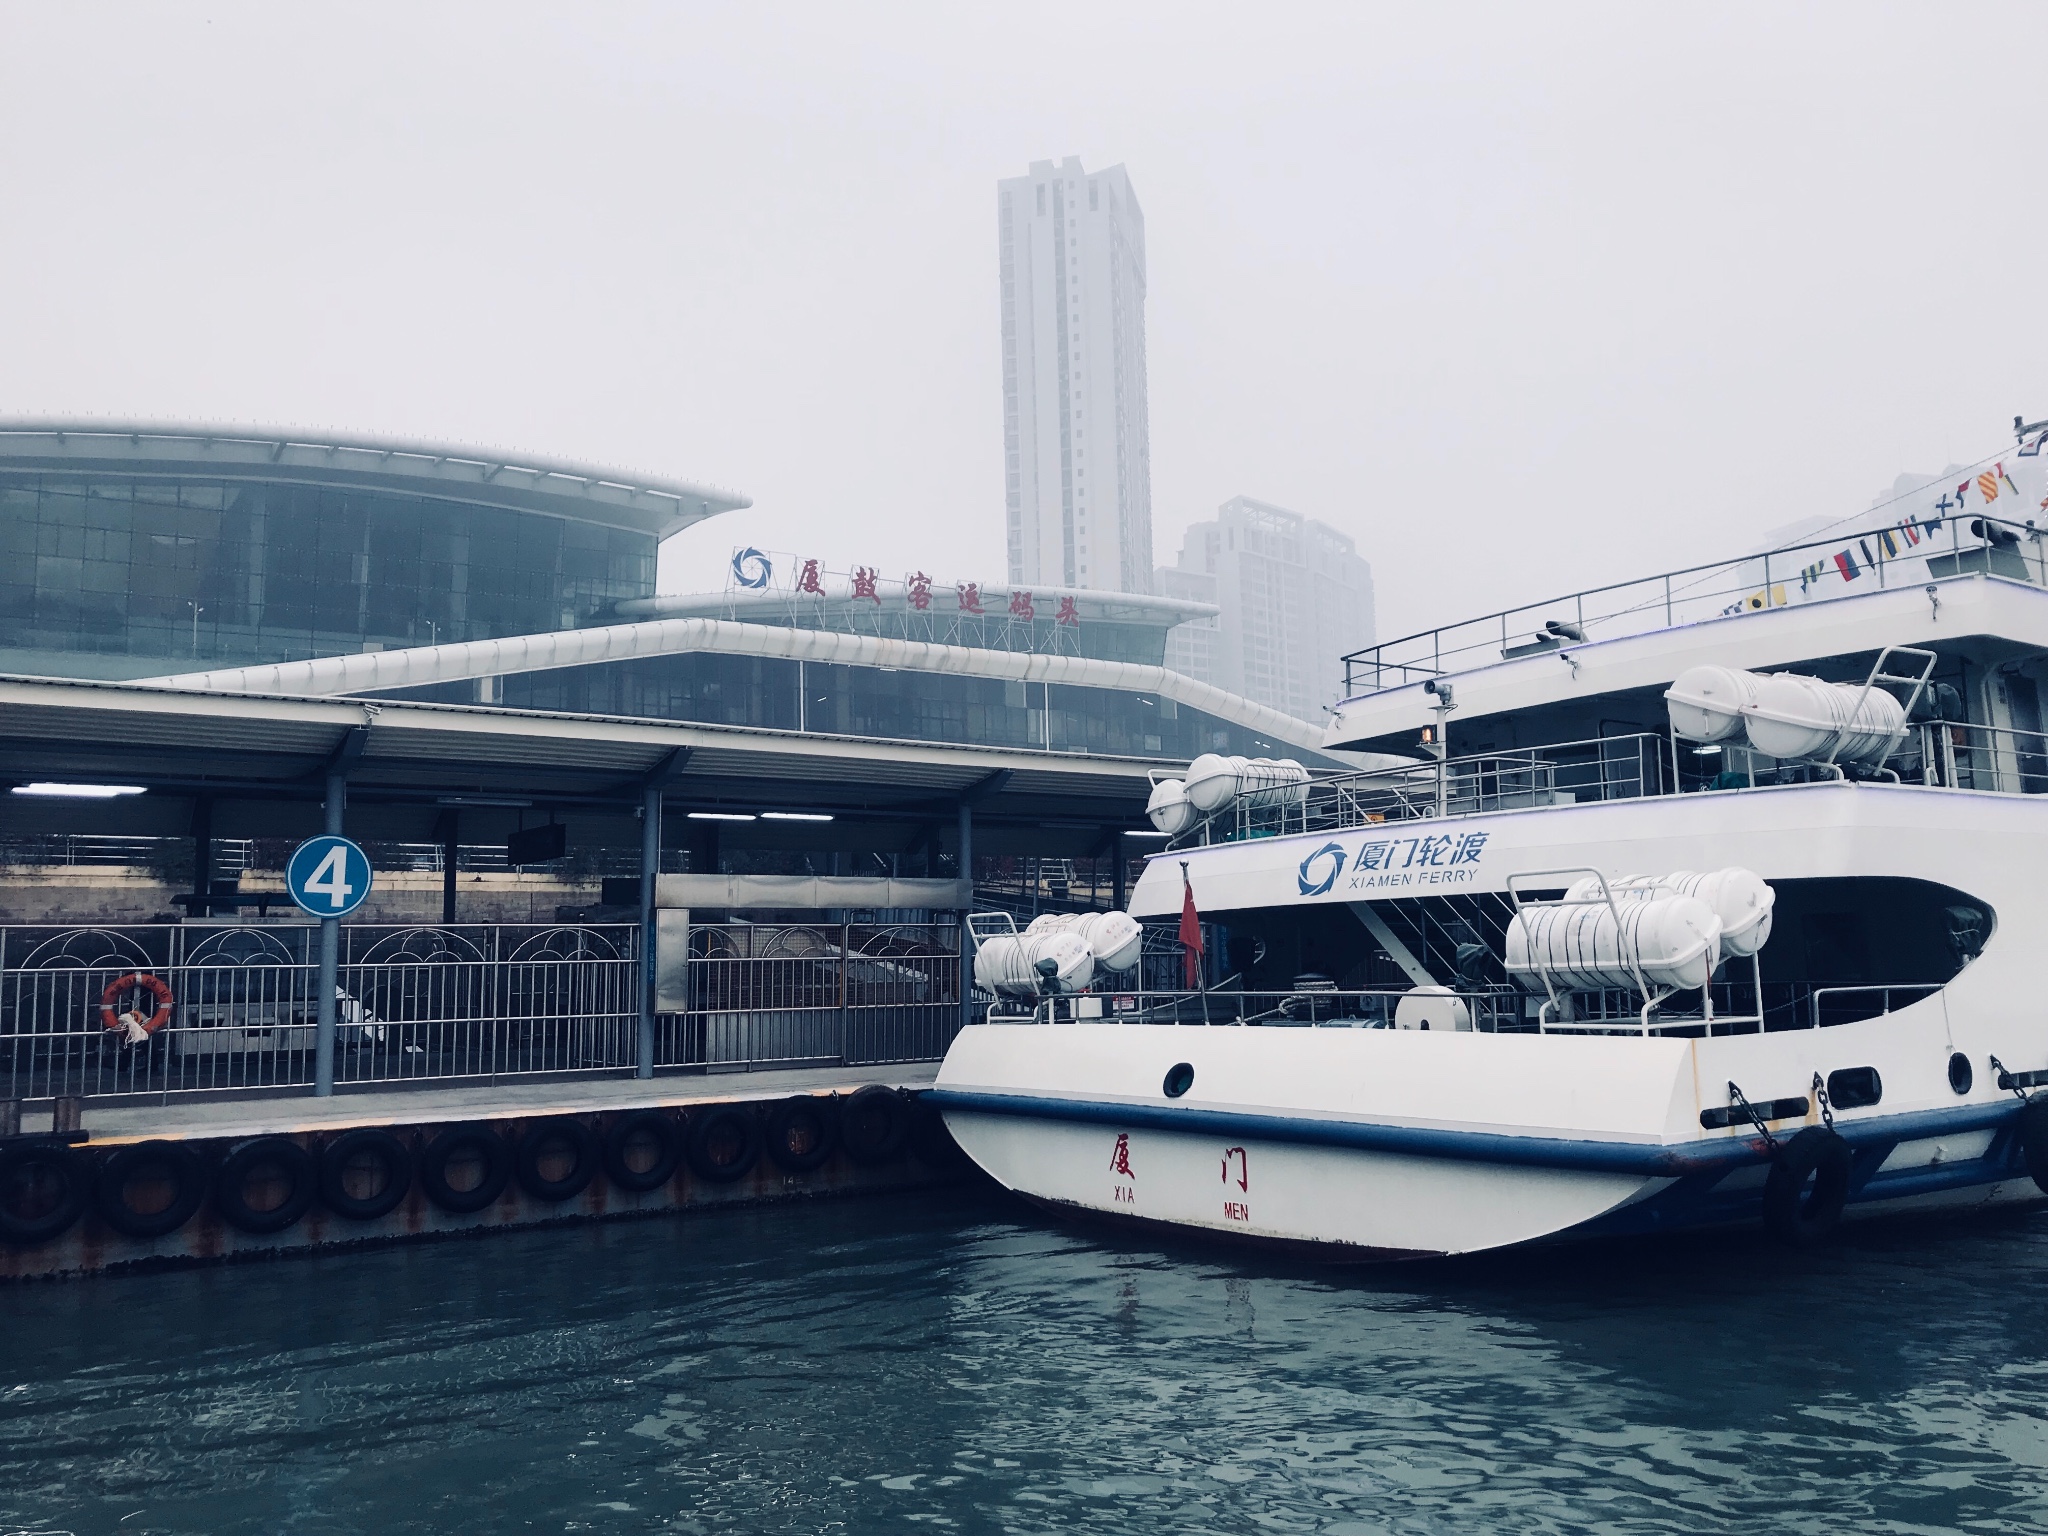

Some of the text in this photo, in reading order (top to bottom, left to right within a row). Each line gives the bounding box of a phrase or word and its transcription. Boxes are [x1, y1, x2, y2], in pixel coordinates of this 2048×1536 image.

[795, 559, 1081, 628] 厦鼓客运码头
[303, 845, 353, 908] 4
[1352, 831, 1490, 872] 厦门轮渡
[1348, 868, 1479, 890] XIAMEN FERRY
[1109, 1132, 1248, 1194] 厦 门
[1114, 1185, 1249, 1222] XIA MEN
